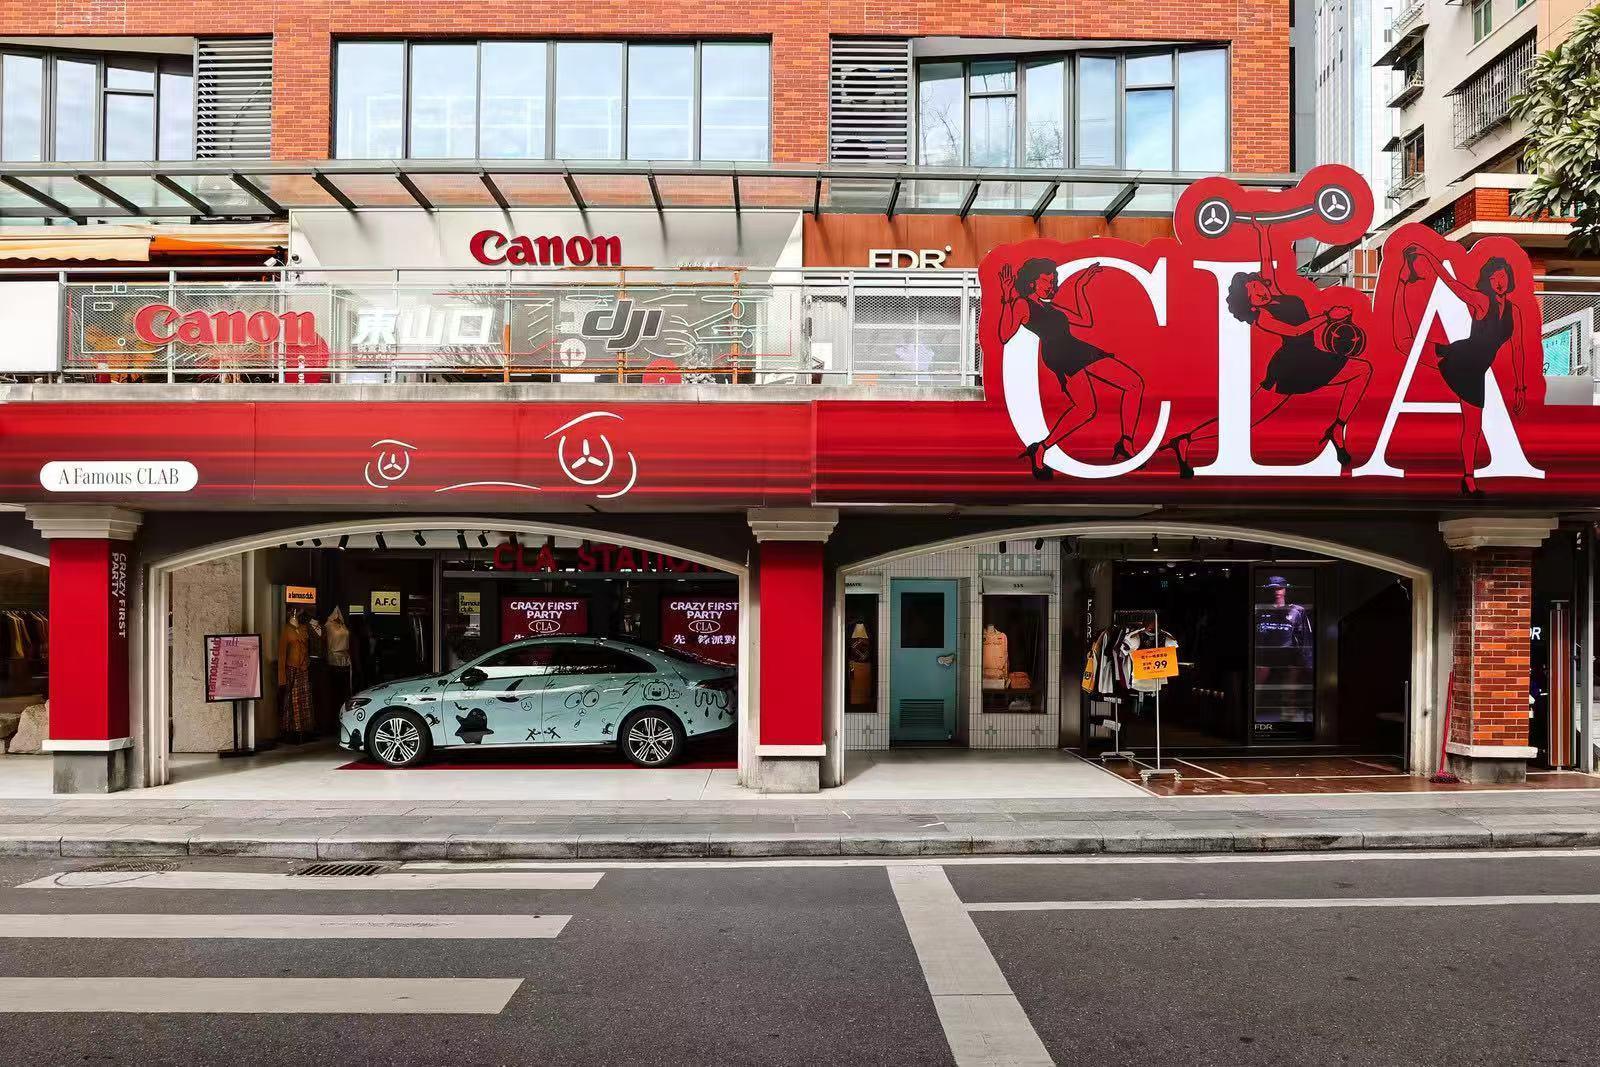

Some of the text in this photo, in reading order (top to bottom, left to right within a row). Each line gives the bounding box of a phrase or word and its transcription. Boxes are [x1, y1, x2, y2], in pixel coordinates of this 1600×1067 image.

[470, 229, 622, 266] Canon
[133, 304, 317, 345] Canon
[351, 304, 499, 345] 東山口
[1003, 255, 1547, 480] CLA
[59, 467, 179, 485] A Famous CLAB
[493, 543, 558, 572] CLA
[119, 553, 127, 597] CRAZY
[374, 597, 397, 607] A.F.C
[511, 602, 579, 610] CRAZY FIRST
[670, 602, 739, 610] CRAZY FIRST
[526, 611, 562, 619] PARTY
[687, 611, 723, 619] PARTY
[536, 622, 553, 631] CLA
[696, 622, 713, 631] CLA
[1254, 723, 1272, 731] FDR
